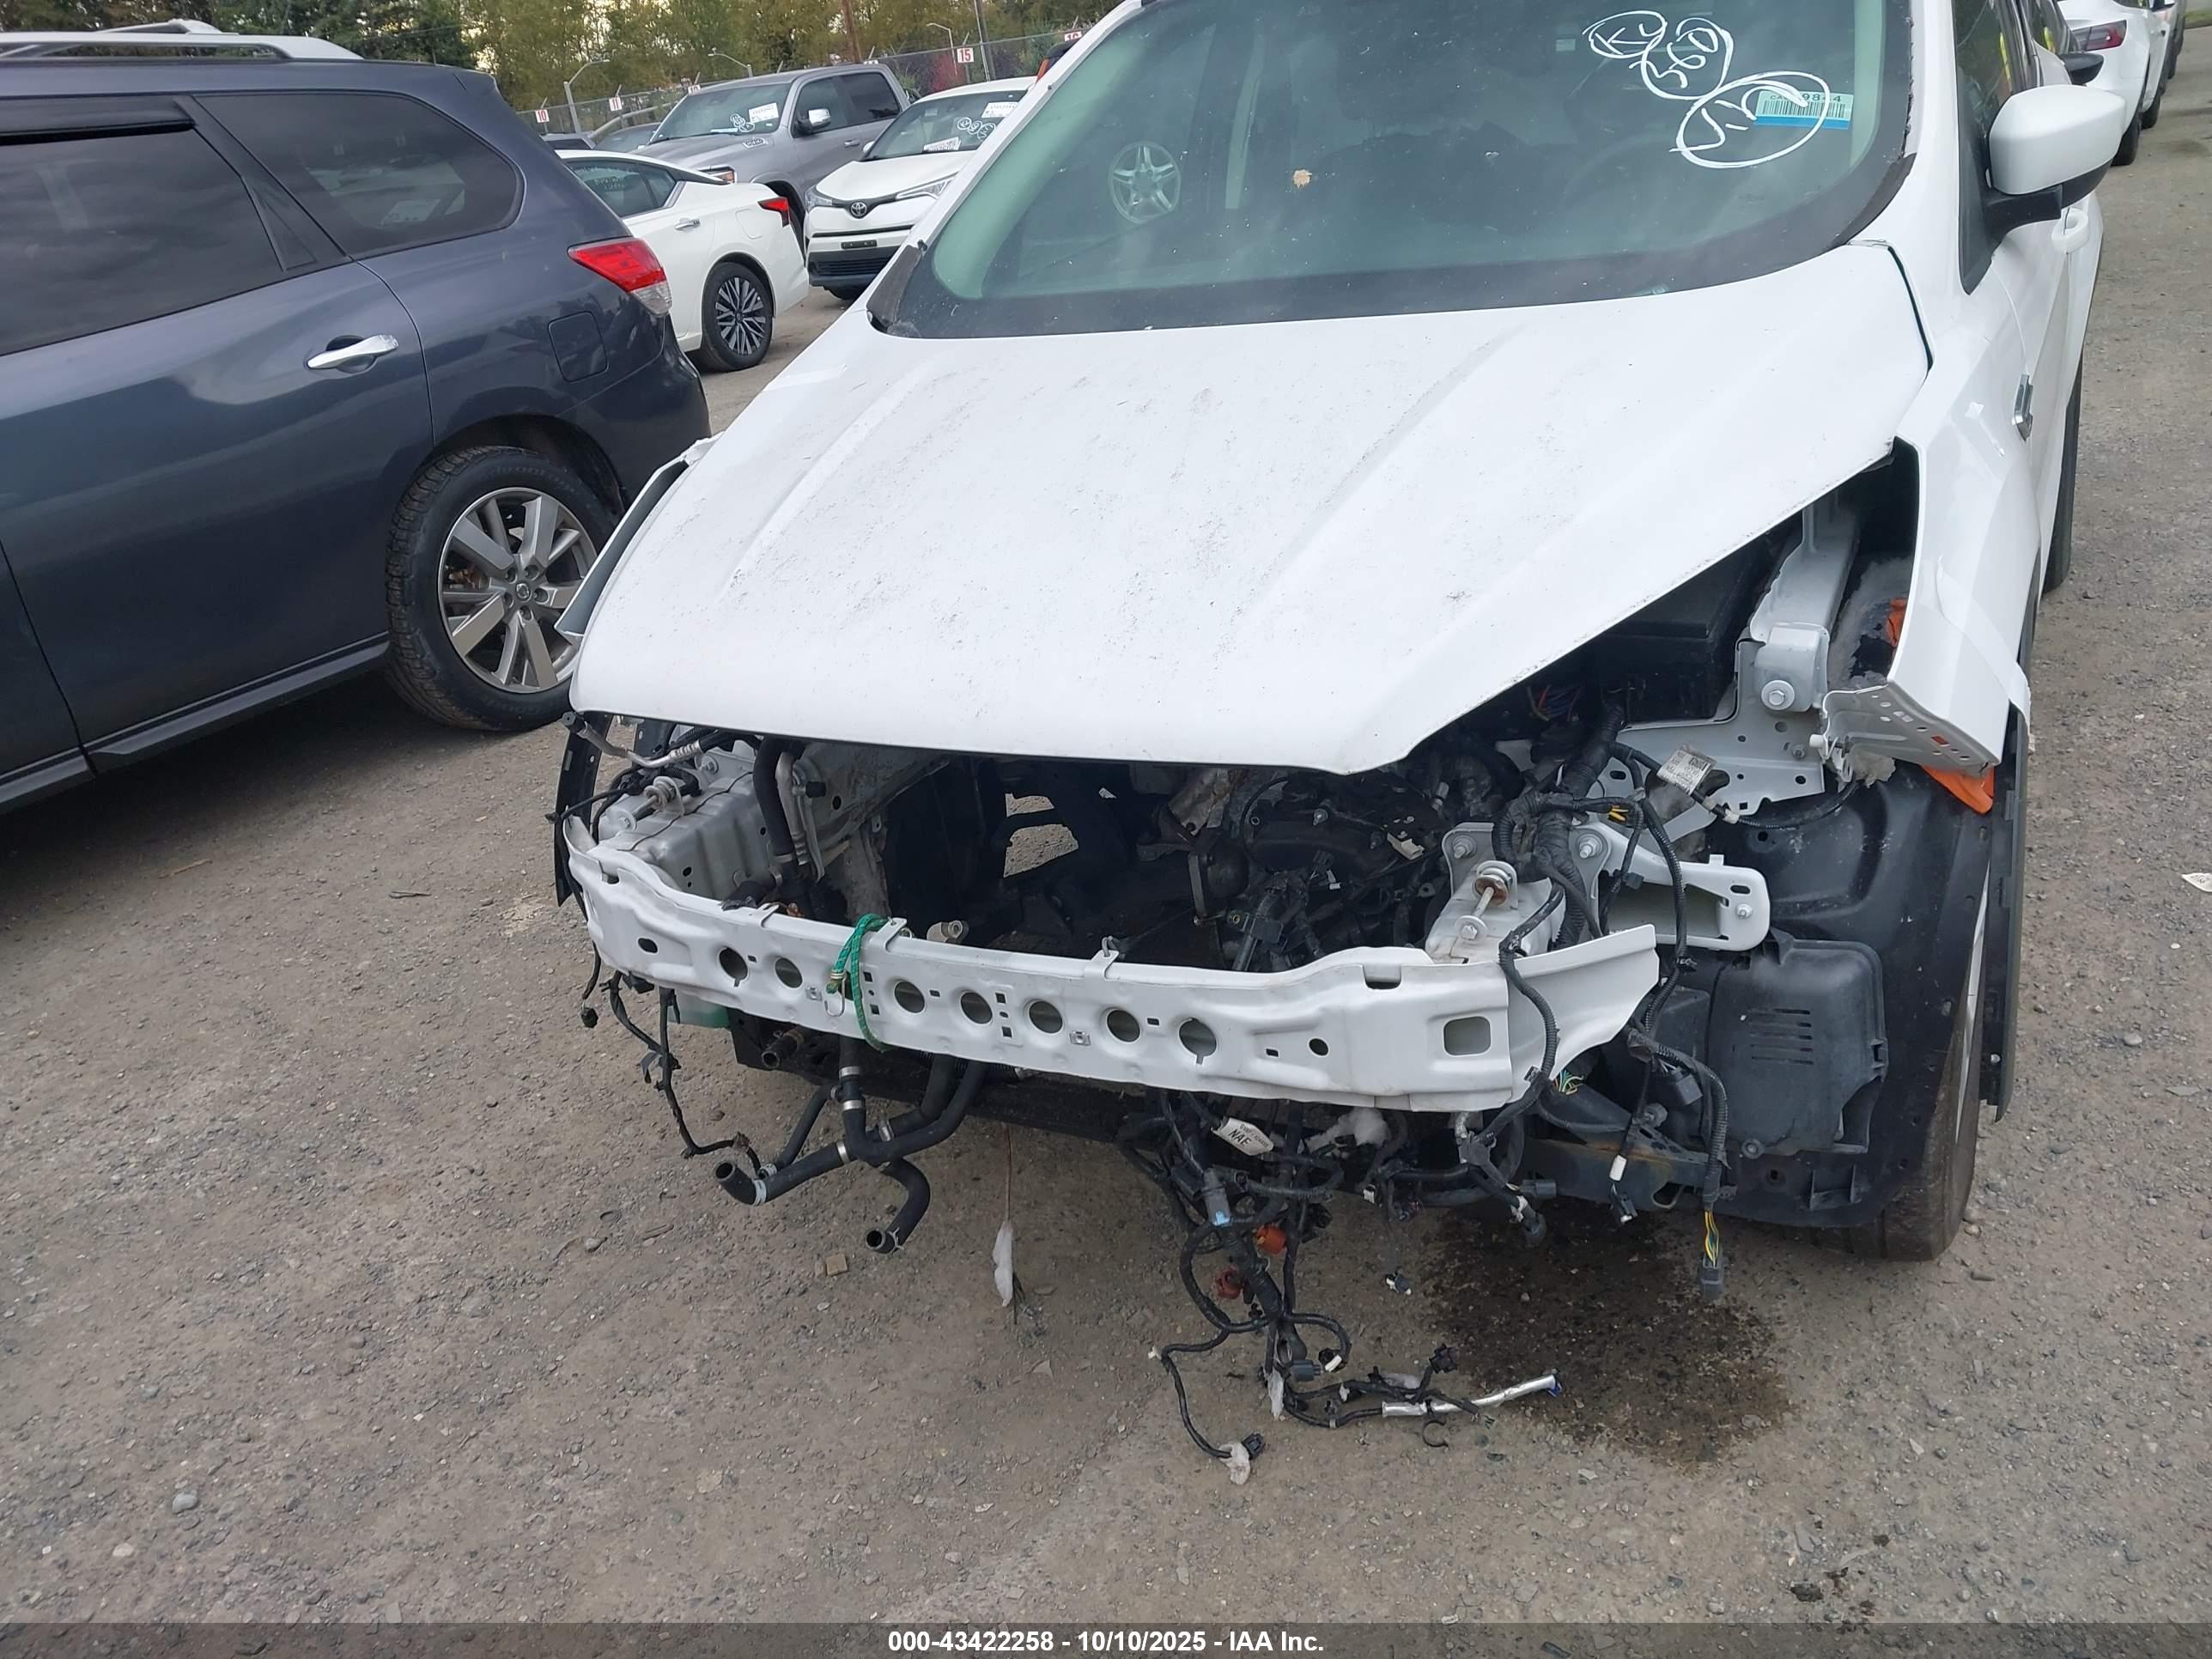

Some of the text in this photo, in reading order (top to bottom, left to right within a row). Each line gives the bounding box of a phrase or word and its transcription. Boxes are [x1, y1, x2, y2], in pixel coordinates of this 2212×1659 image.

[959, 50, 971, 63] 15
[611, 99, 620, 110] 11
[537, 110, 547, 122] 10
